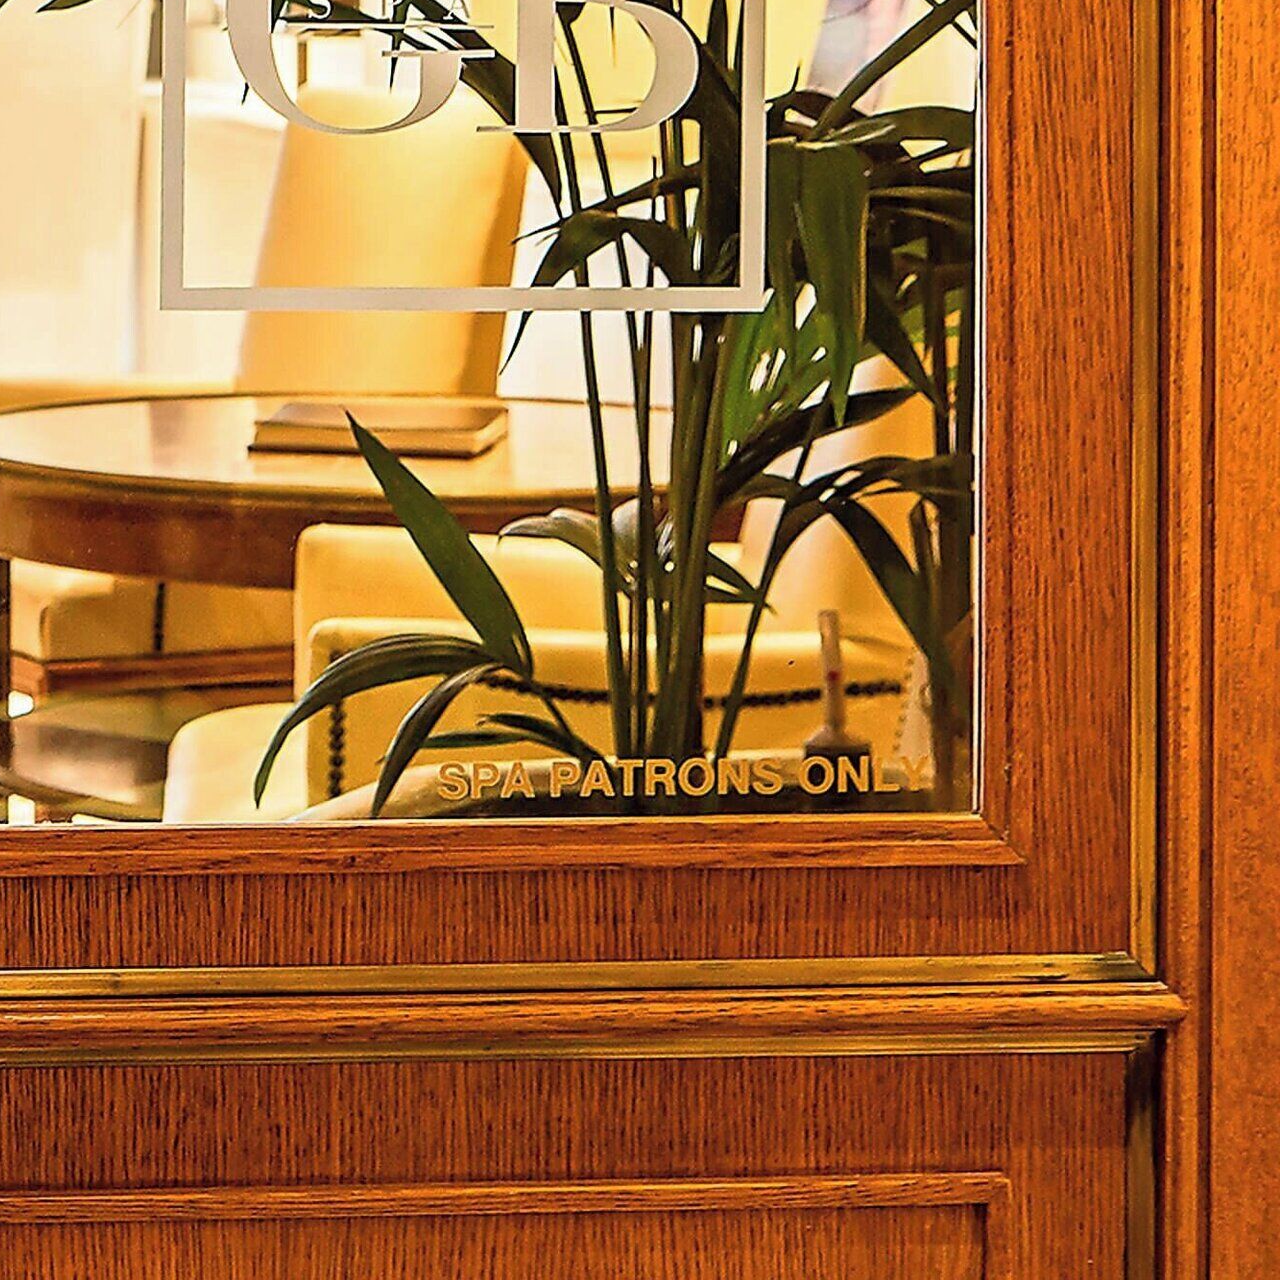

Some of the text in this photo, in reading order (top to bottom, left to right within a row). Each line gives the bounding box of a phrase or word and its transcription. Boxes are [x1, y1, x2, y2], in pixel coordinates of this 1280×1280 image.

[439, 755, 929, 801] SPA PATRONS ONLY
